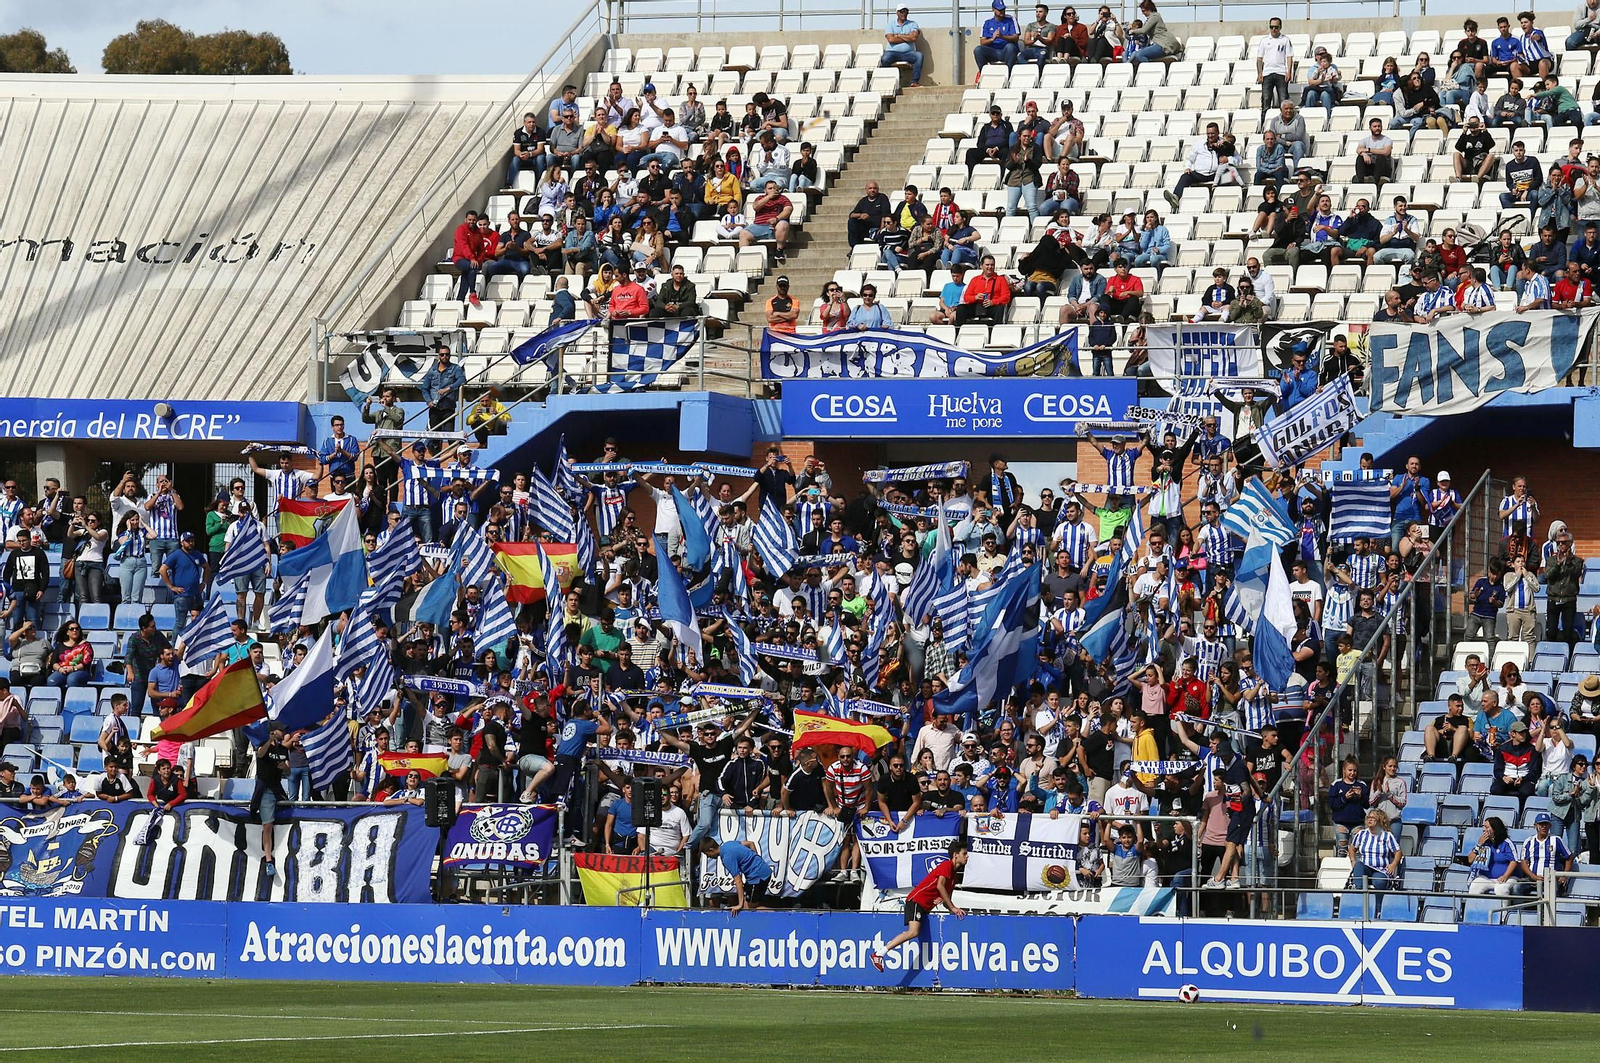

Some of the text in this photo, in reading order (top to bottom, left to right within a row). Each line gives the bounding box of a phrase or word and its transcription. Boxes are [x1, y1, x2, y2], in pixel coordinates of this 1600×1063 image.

[1370, 321, 1531, 412] FANS
[811, 391, 1112, 422] CEOSA Huelva CEOSA
[86, 411, 124, 438] del
[946, 417, 1003, 431] me pone
[1273, 391, 1351, 452] GOLFOS
[644, 750, 685, 764] ONUBA
[450, 843, 540, 860] ONUBAS
[972, 838, 1074, 859] Banda Suicida
[584, 854, 670, 872] ULTRAS
[54, 905, 169, 932] MARTÍN
[239, 921, 626, 968] Atraccioneslacinta.com
